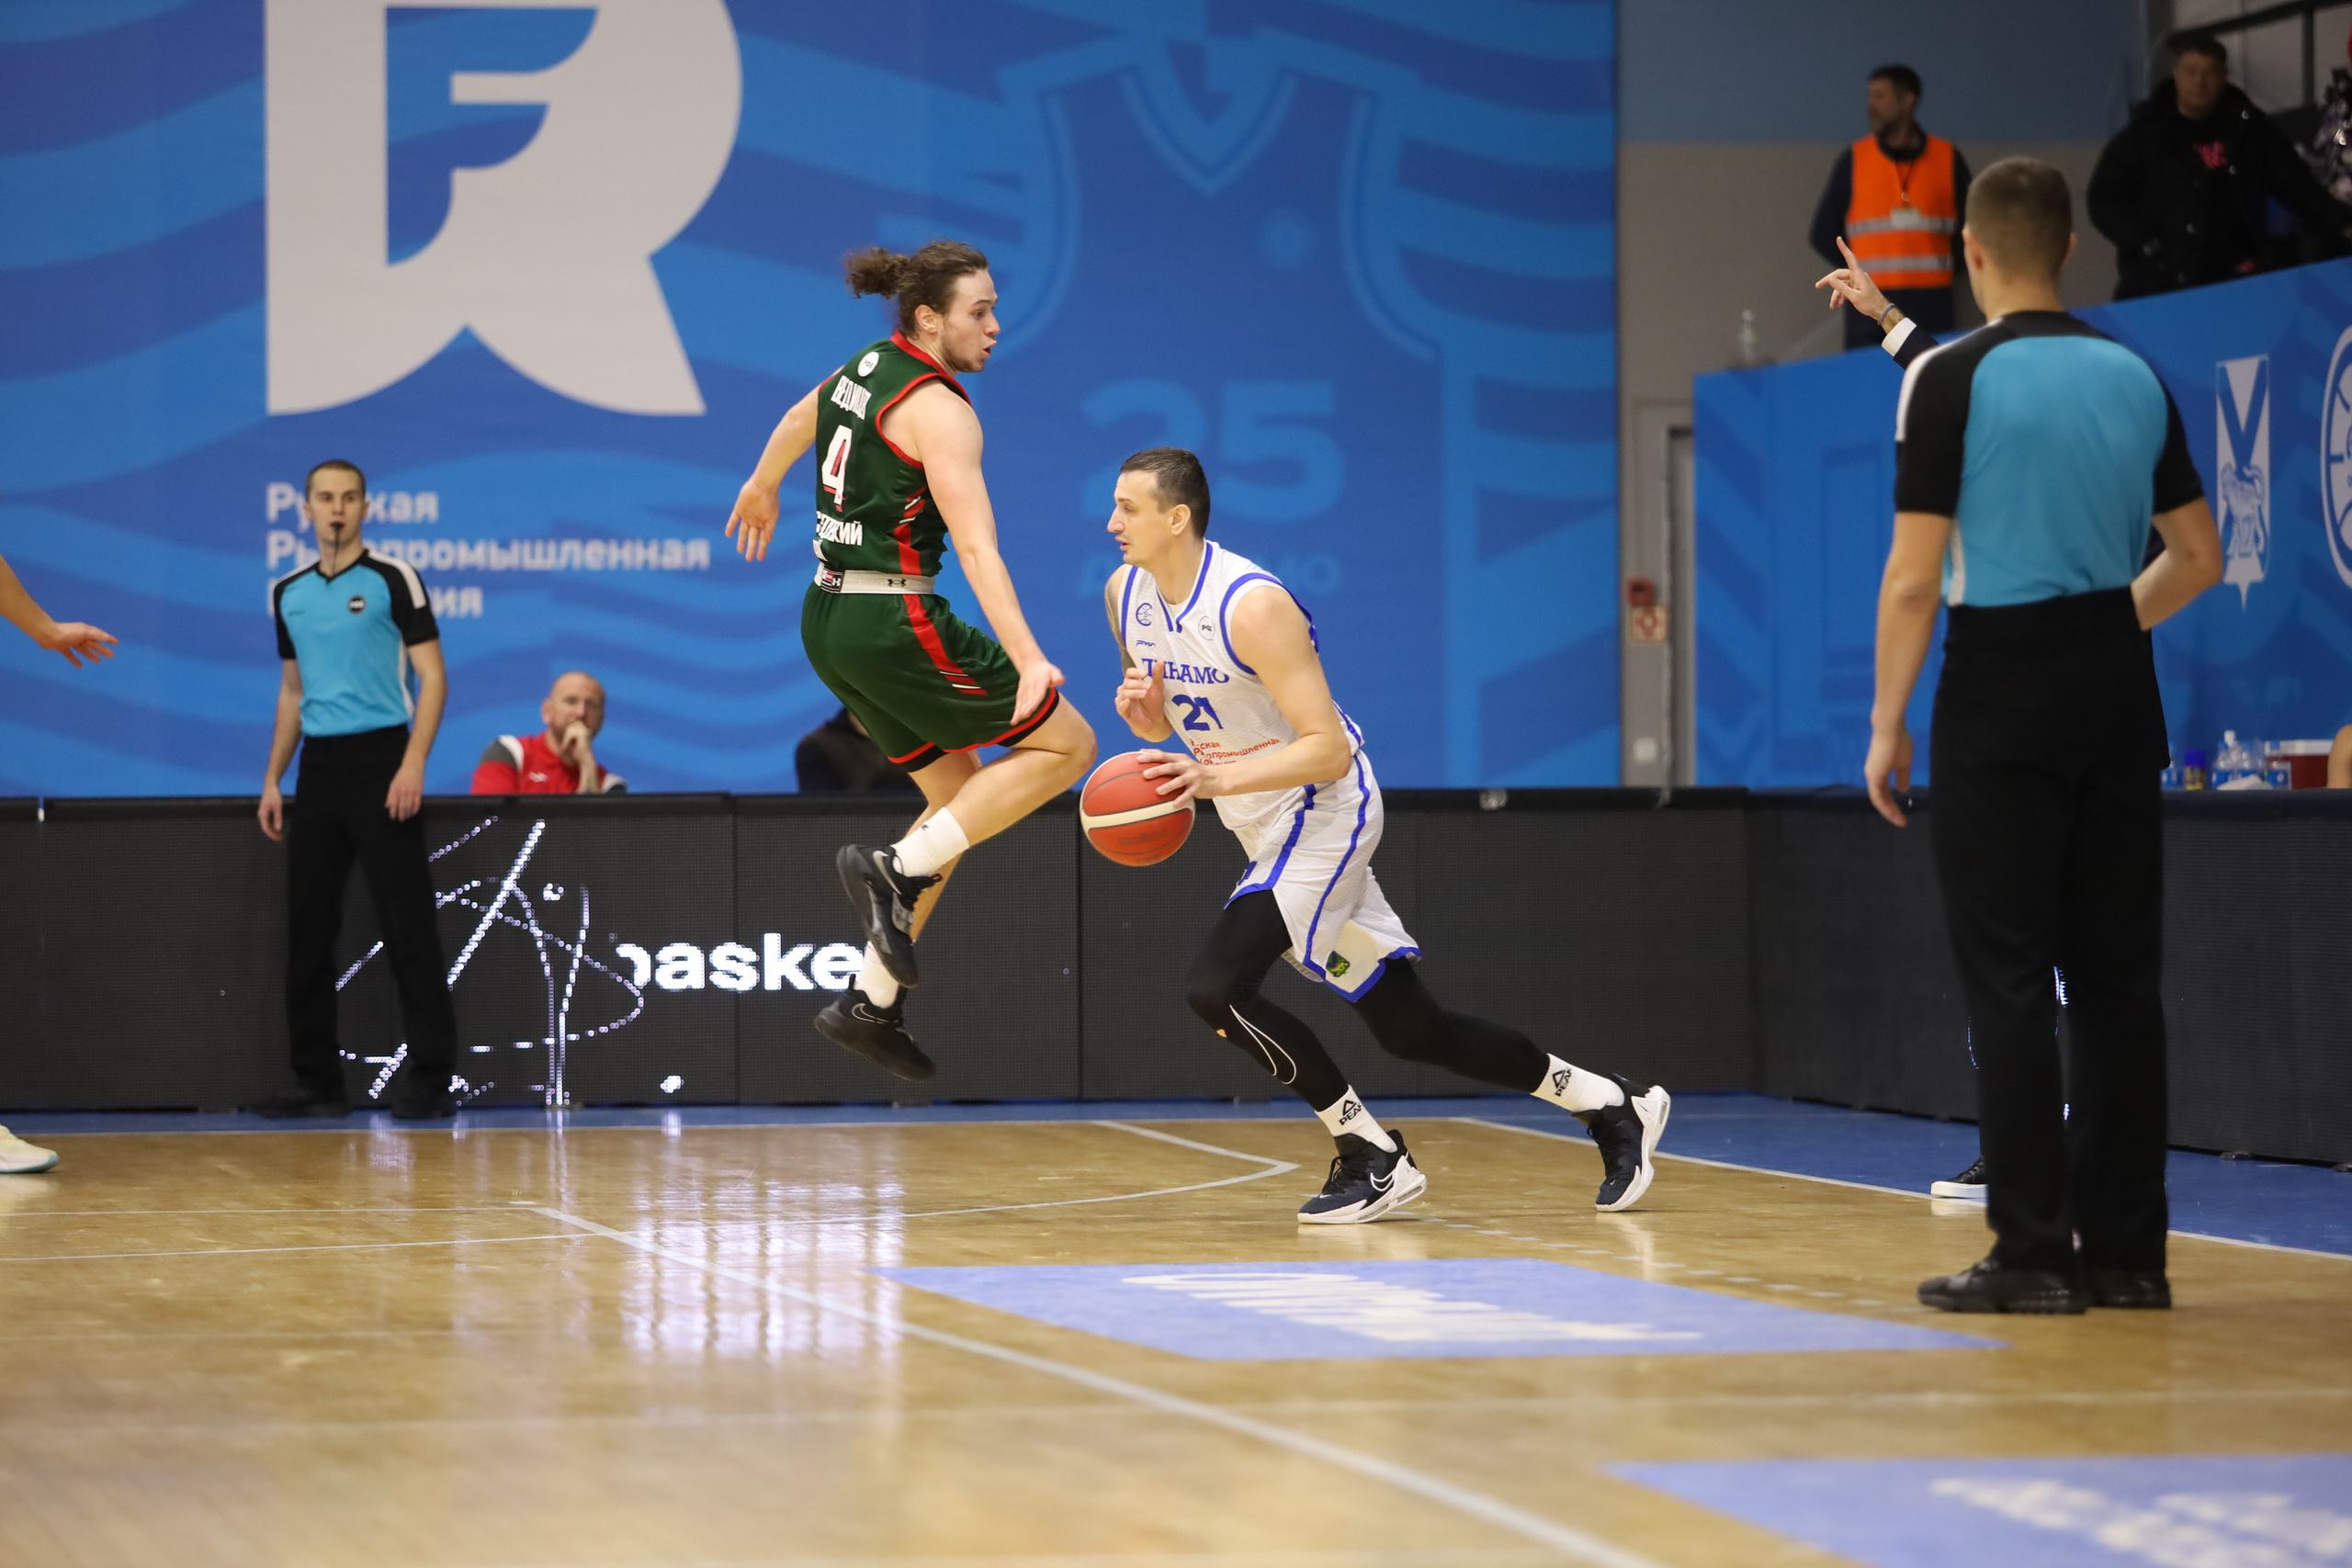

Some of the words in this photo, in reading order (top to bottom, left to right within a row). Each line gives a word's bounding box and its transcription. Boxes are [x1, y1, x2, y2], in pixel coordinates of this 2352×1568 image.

[821, 425, 852, 512] 4
[266, 482, 439, 533] Рукая
[266, 530, 711, 571] Рыпромышленная
[1171, 694, 1224, 732] 21
